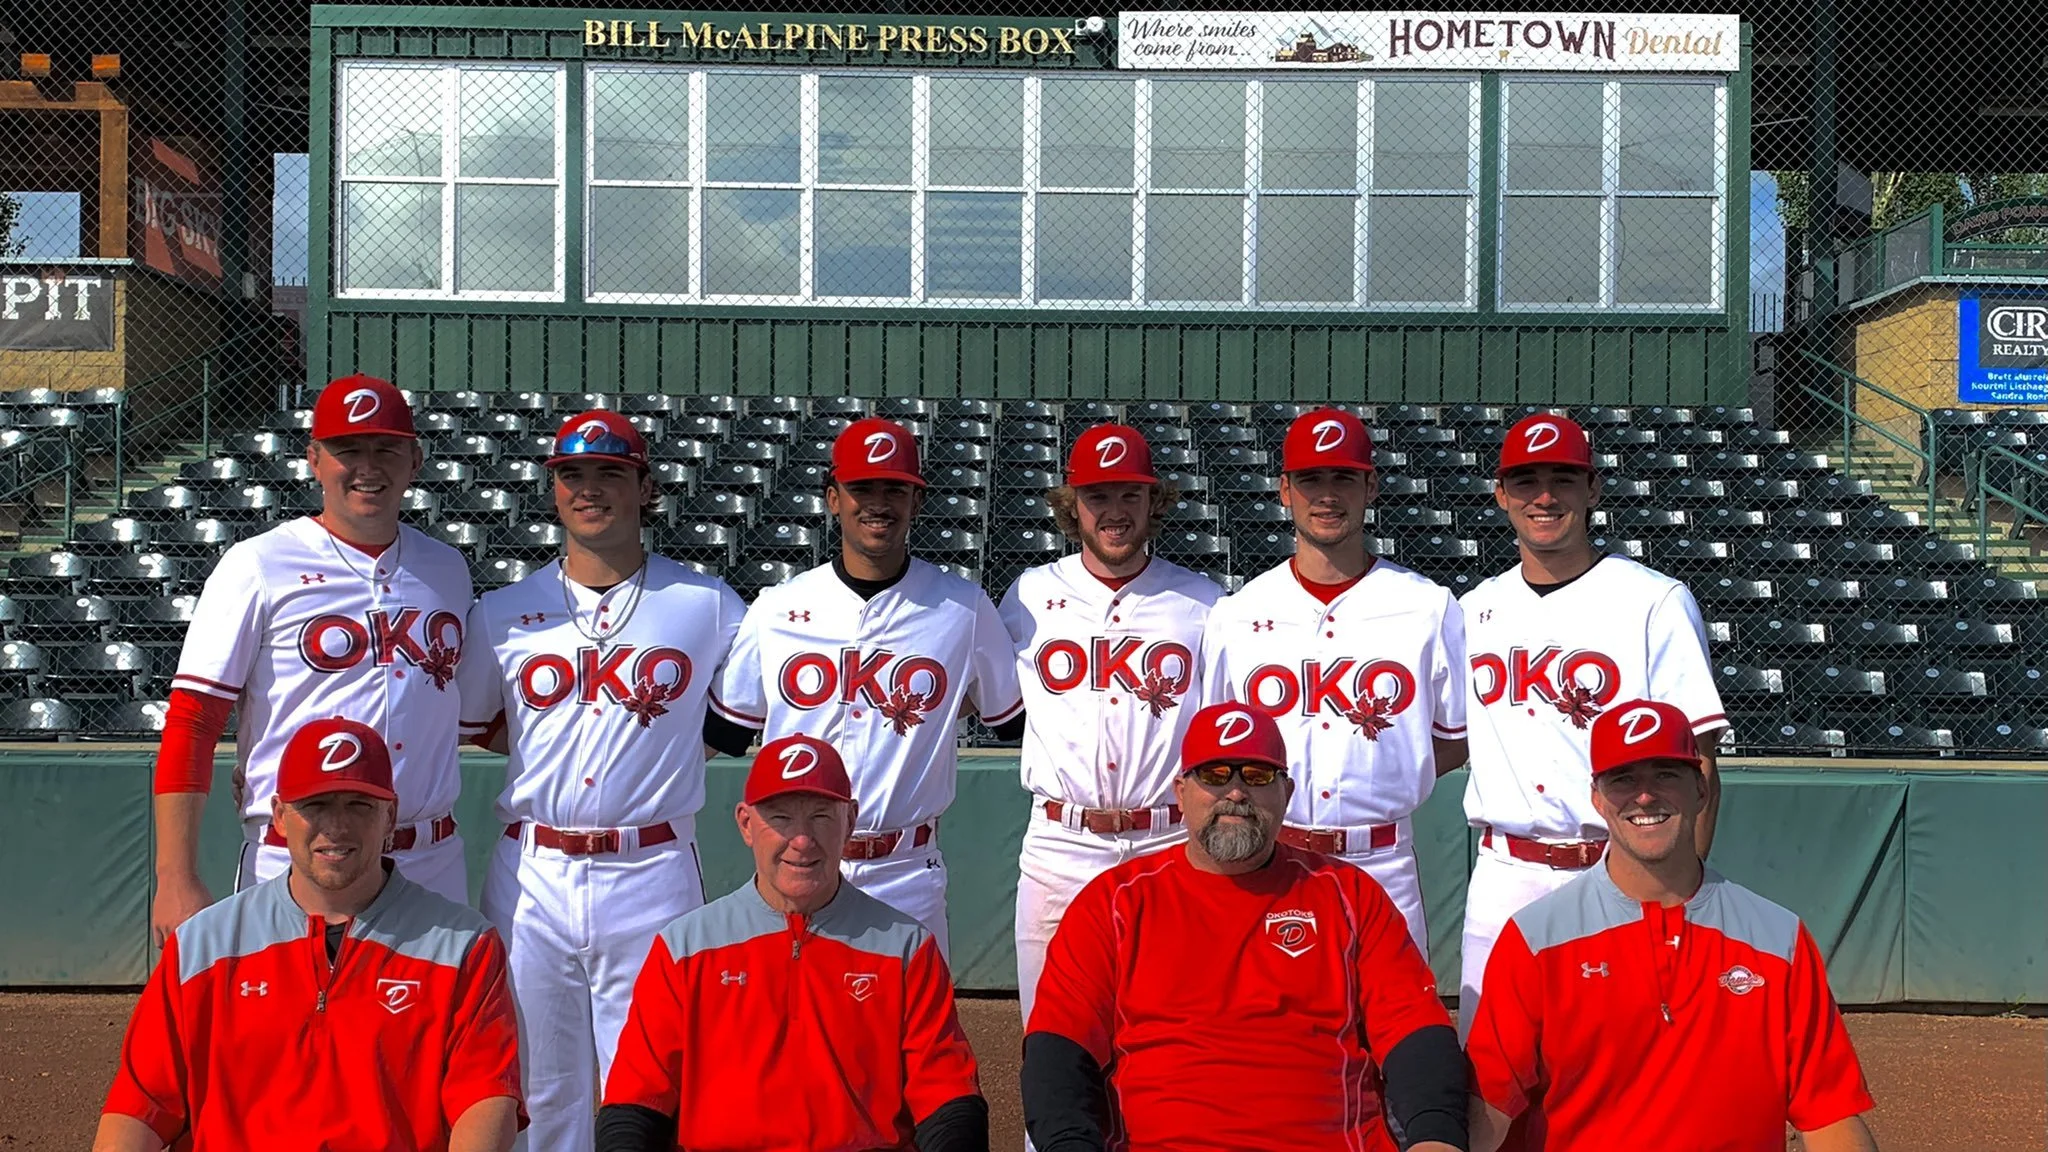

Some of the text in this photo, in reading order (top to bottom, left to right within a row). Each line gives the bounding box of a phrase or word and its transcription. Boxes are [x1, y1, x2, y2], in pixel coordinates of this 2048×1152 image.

[583, 20, 1076, 55] BILL McALPINE PRESS BOX
[1128, 18, 1257, 38] Where smiles
[1388, 19, 1723, 62] HOMETOWN Dental
[1134, 42, 1186, 56] come
[2, 277, 101, 320] PIT
[343, 388, 381, 423] D
[864, 432, 897, 464] D
[1095, 436, 1128, 468] D
[1312, 420, 1346, 452] D
[1525, 423, 1561, 452] D
[298, 607, 462, 673] OKO
[516, 644, 692, 711] OKO
[778, 647, 948, 711] OKO
[1034, 635, 1193, 695] OKO
[1243, 657, 1416, 720] OKO
[1215, 710, 1254, 746] D
[1617, 707, 1662, 745] D
[318, 731, 362, 772] D
[779, 743, 819, 780] D
[1266, 909, 1314, 919] OKOTOKS
[1277, 921, 1307, 948] D
[386, 984, 408, 1006] D
